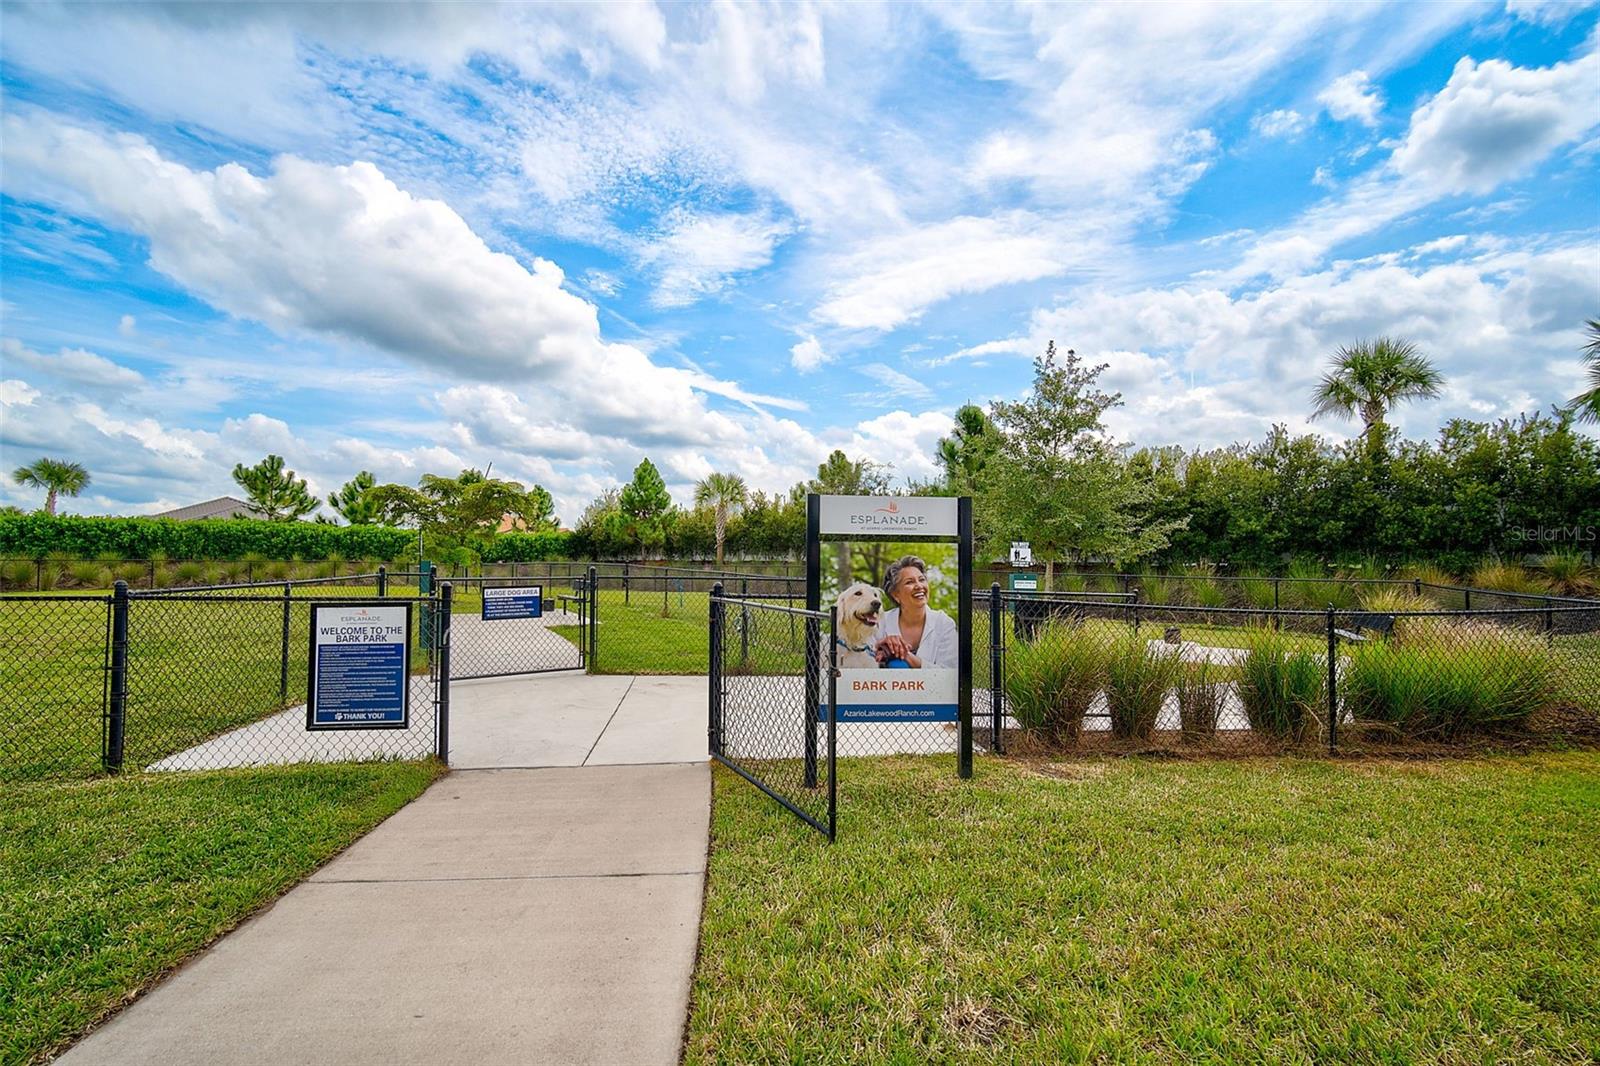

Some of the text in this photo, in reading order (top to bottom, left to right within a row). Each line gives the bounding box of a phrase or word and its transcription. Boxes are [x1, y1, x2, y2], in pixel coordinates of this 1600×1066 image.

[320, 626, 403, 635] WELCOME TO THE
[335, 634, 388, 643] BARK PARK
[853, 681, 925, 691] BARK PARK
[367, 712, 385, 720] YOU!
[843, 709, 935, 717] AzarioLakewoodRanch.com
